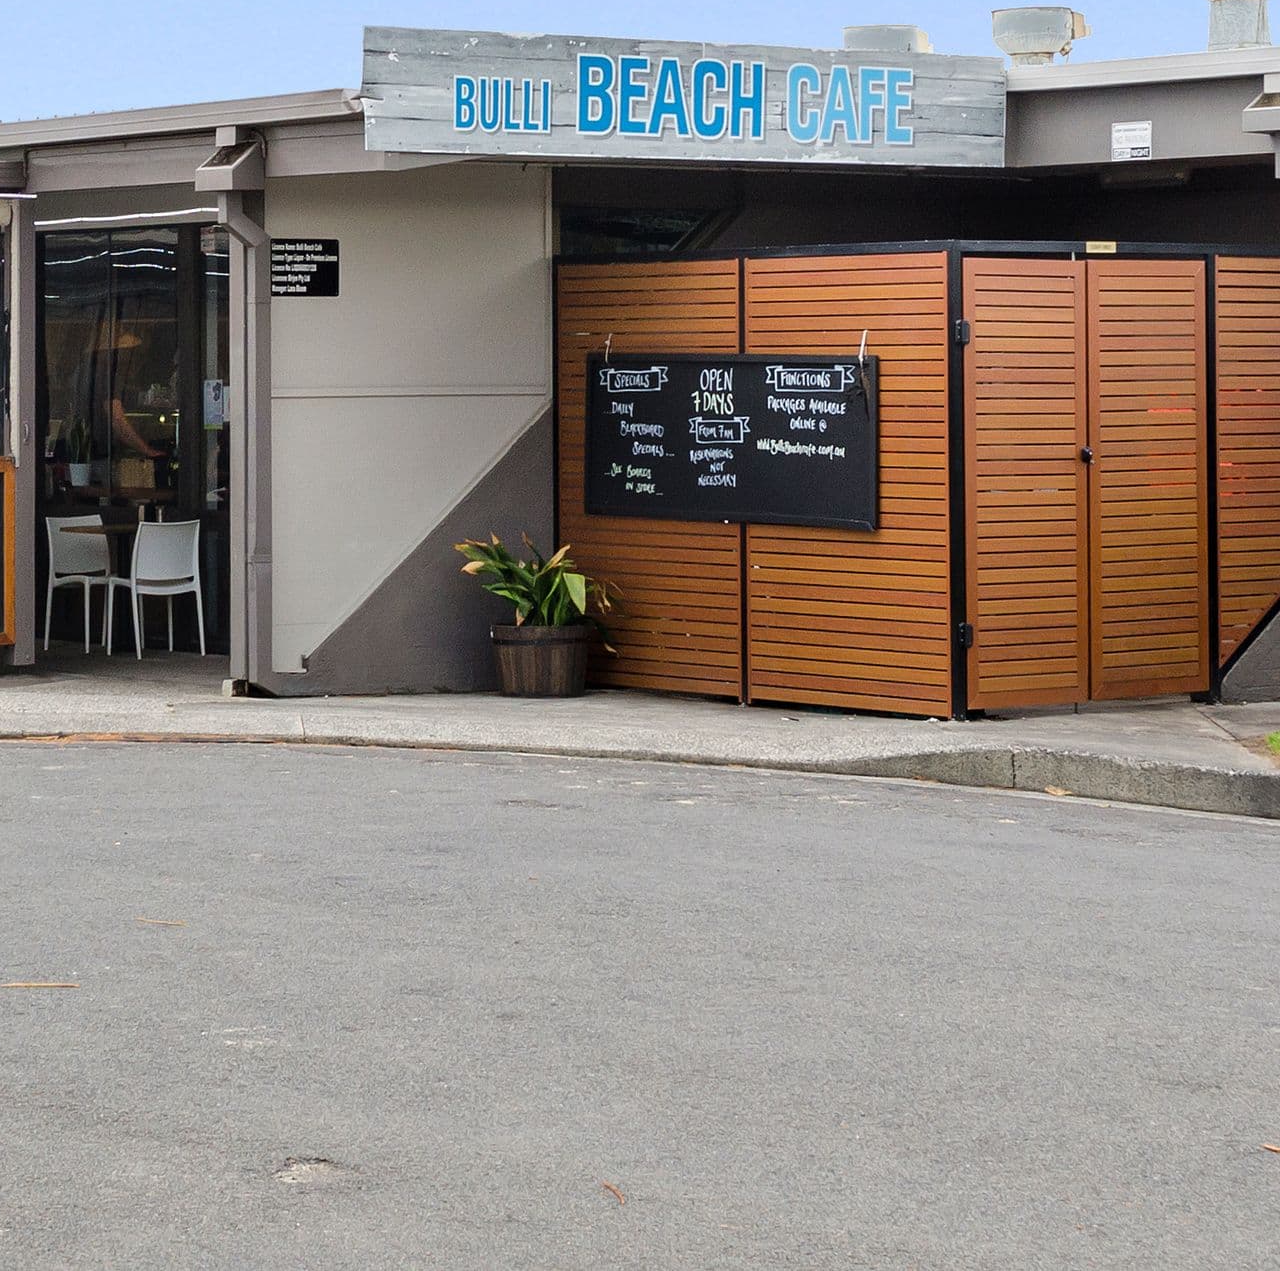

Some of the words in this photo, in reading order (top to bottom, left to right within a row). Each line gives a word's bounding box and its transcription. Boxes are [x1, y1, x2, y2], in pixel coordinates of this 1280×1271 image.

[453, 75, 552, 134] BULLI
[576, 53, 765, 140] BEACH
[786, 63, 915, 145] CAFE
[614, 373, 650, 388] SPECIALS
[700, 368, 733, 391] OPEN
[780, 371, 831, 388] FUNCTIONS
[691, 390, 701, 413] 7
[703, 391, 734, 415] DAYS
[767, 395, 806, 415] PACKAGES
[809, 398, 847, 415] AVAILABLE
[790, 416, 816, 430] ONLINE
[818, 419, 827, 433] @
[710, 460, 726, 473] NOT
[697, 474, 736, 488] NECESSARY
